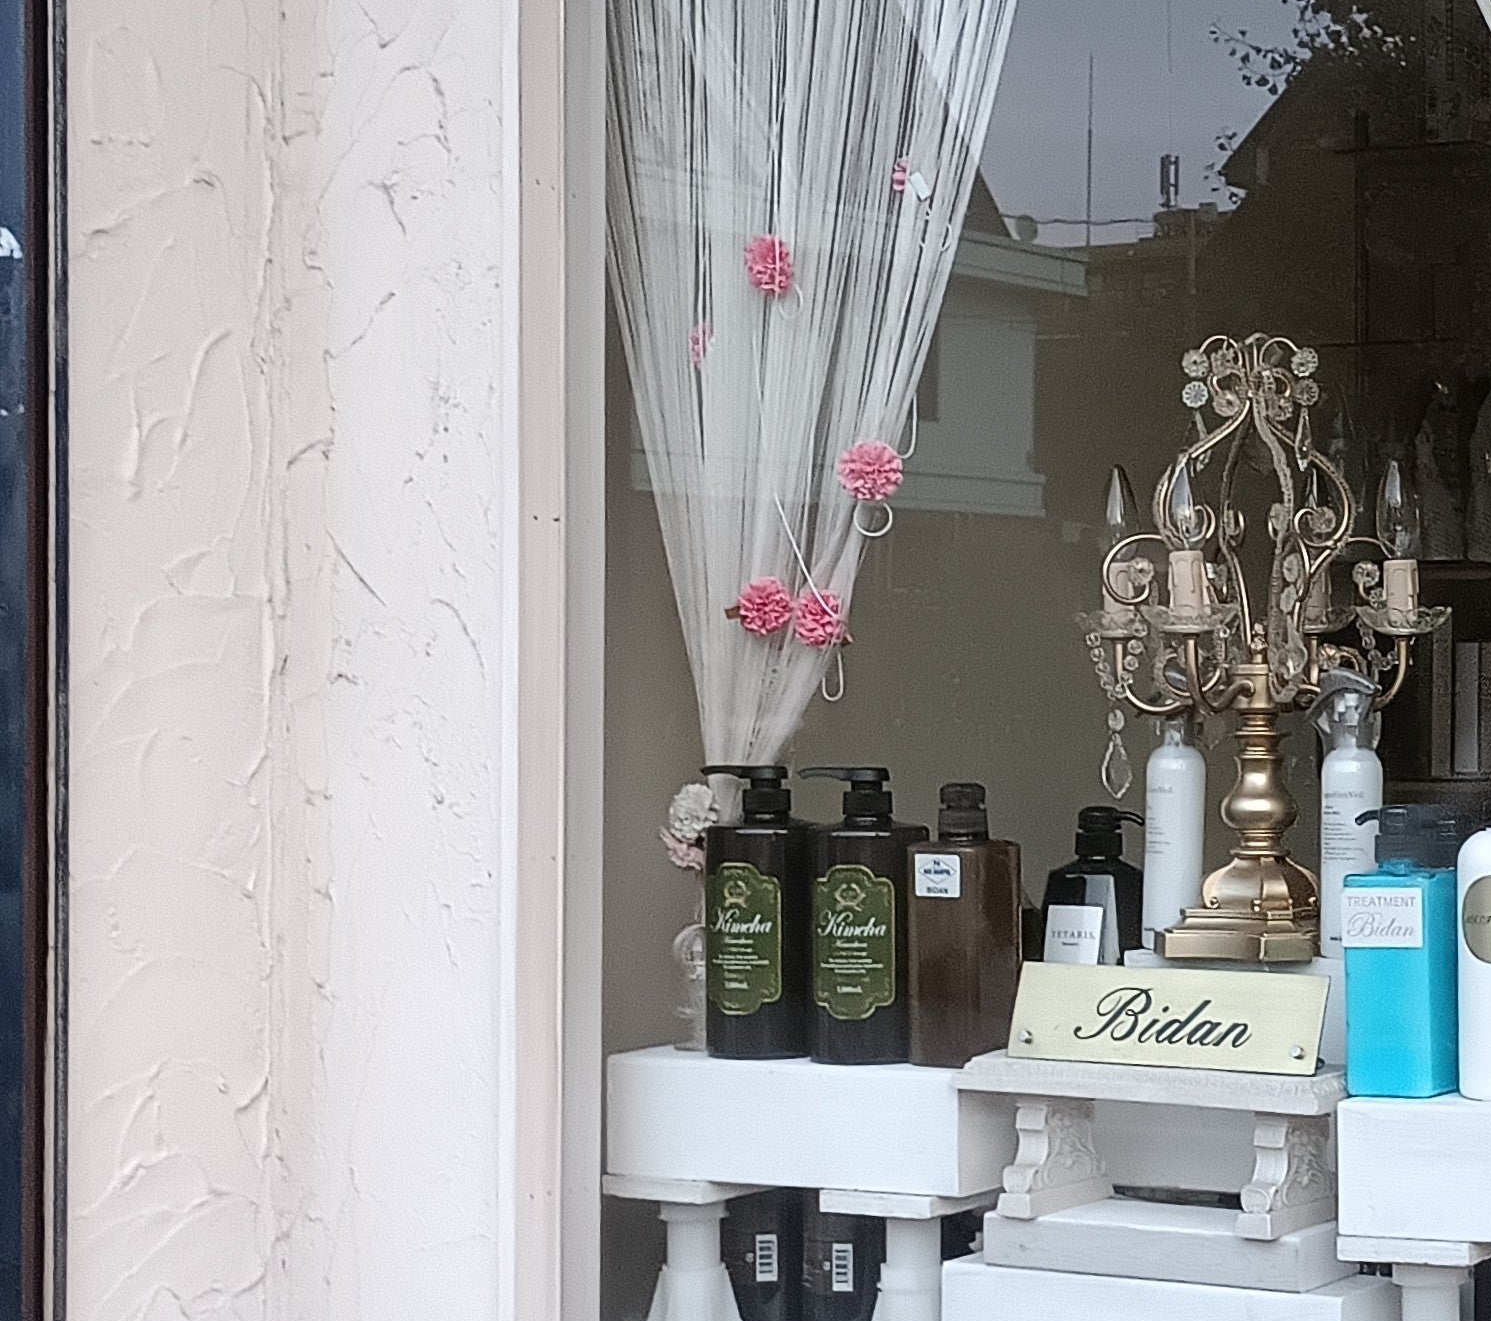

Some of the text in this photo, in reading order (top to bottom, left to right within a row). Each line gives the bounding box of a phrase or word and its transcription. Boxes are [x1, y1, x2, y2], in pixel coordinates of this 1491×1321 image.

[1347, 895, 1416, 907] TREATMENT
[1347, 911, 1415, 938] Bidan
[1073, 986, 1253, 1049] Bidan
